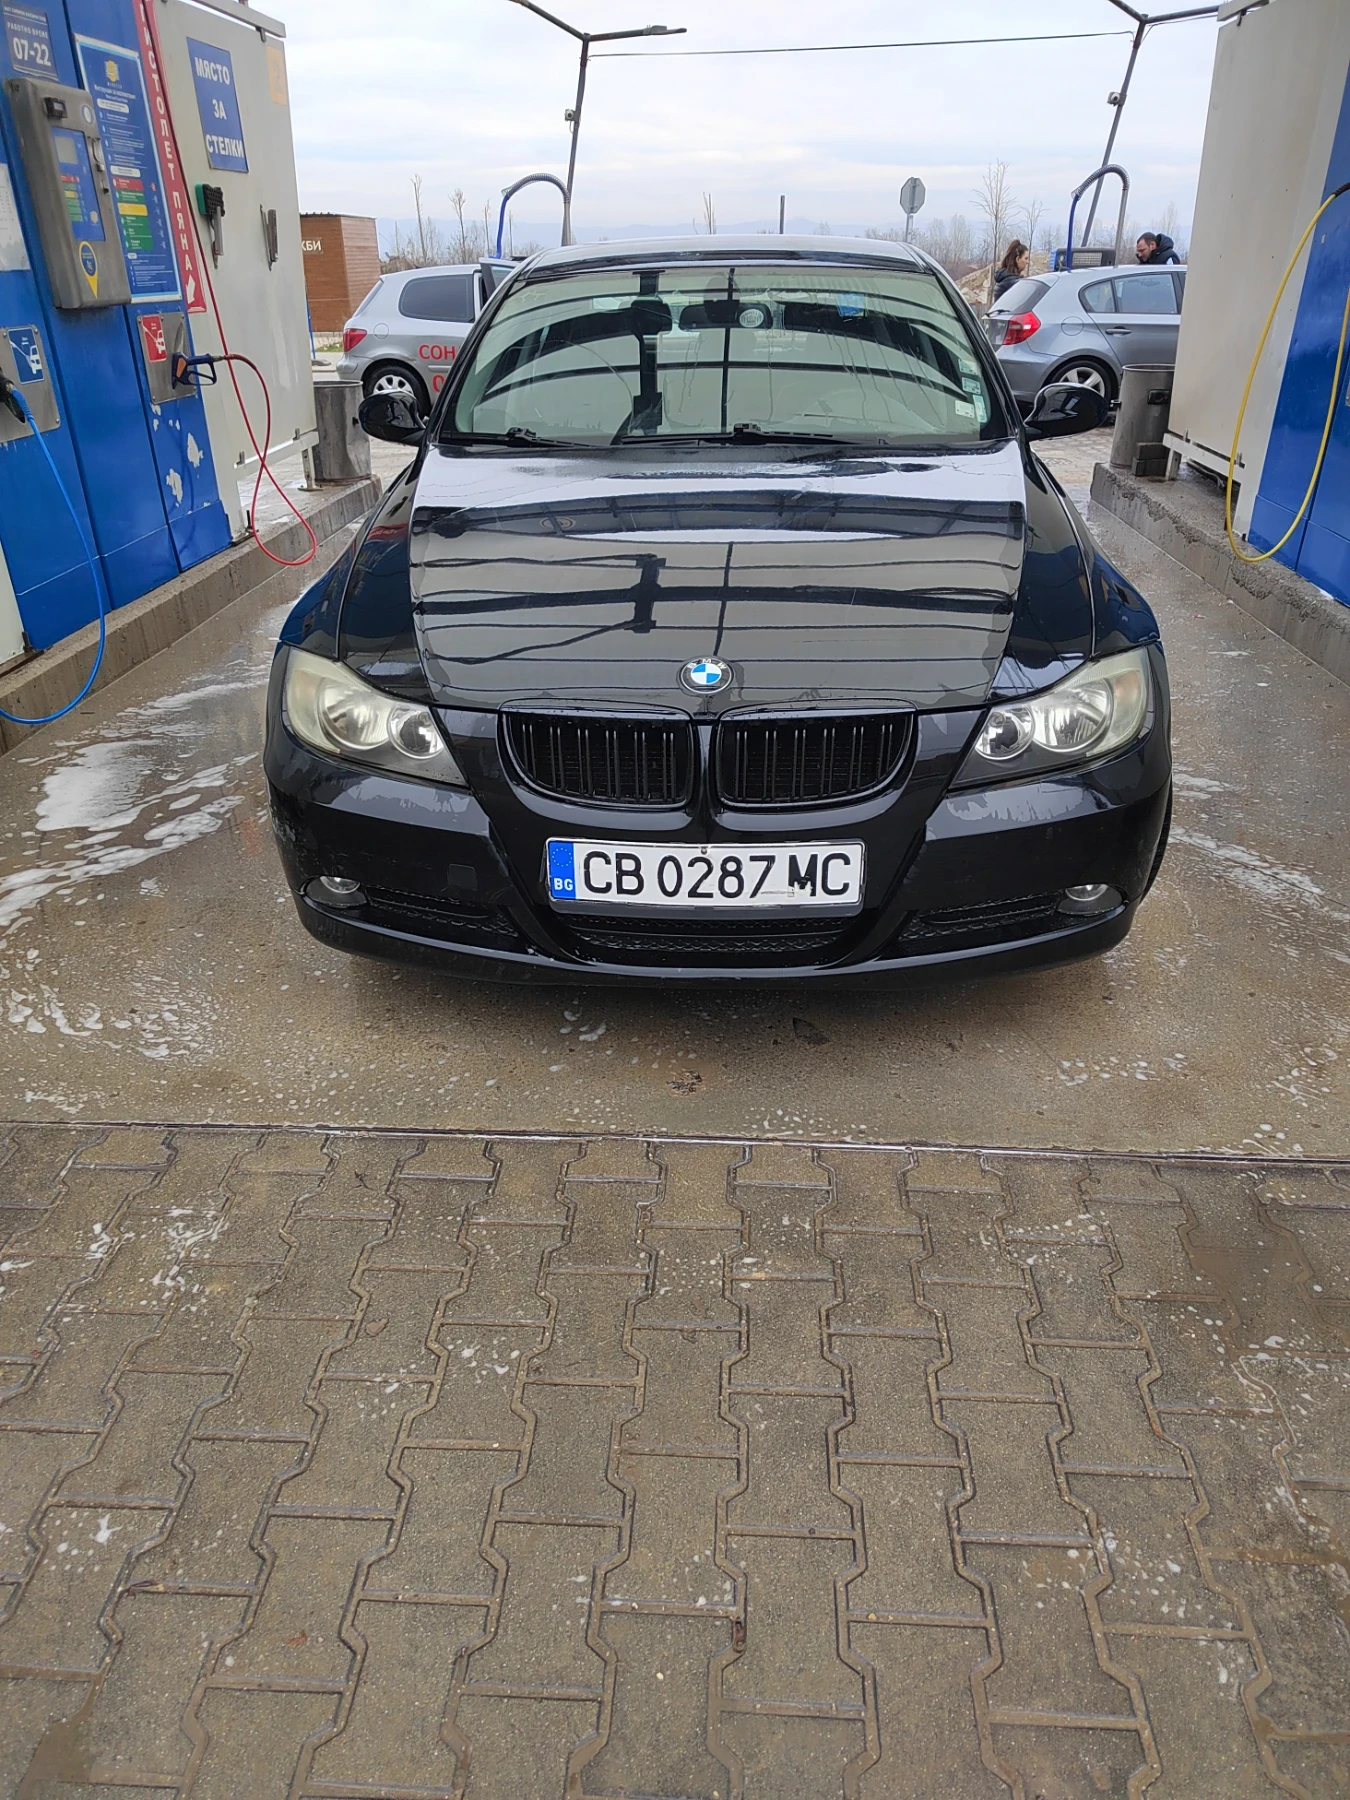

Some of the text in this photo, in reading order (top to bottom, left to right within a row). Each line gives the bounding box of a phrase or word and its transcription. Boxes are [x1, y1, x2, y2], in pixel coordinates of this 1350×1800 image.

[13, 37, 52, 67] 07-22
[194, 57, 230, 85] МЯСТО
[212, 99, 227, 120] ЗА
[205, 134, 245, 158] СТЕЛКИ
[173, 191, 192, 271] ПЯНА
[553, 878, 574, 891] BG
[583, 850, 852, 899] CB 0287 MC
